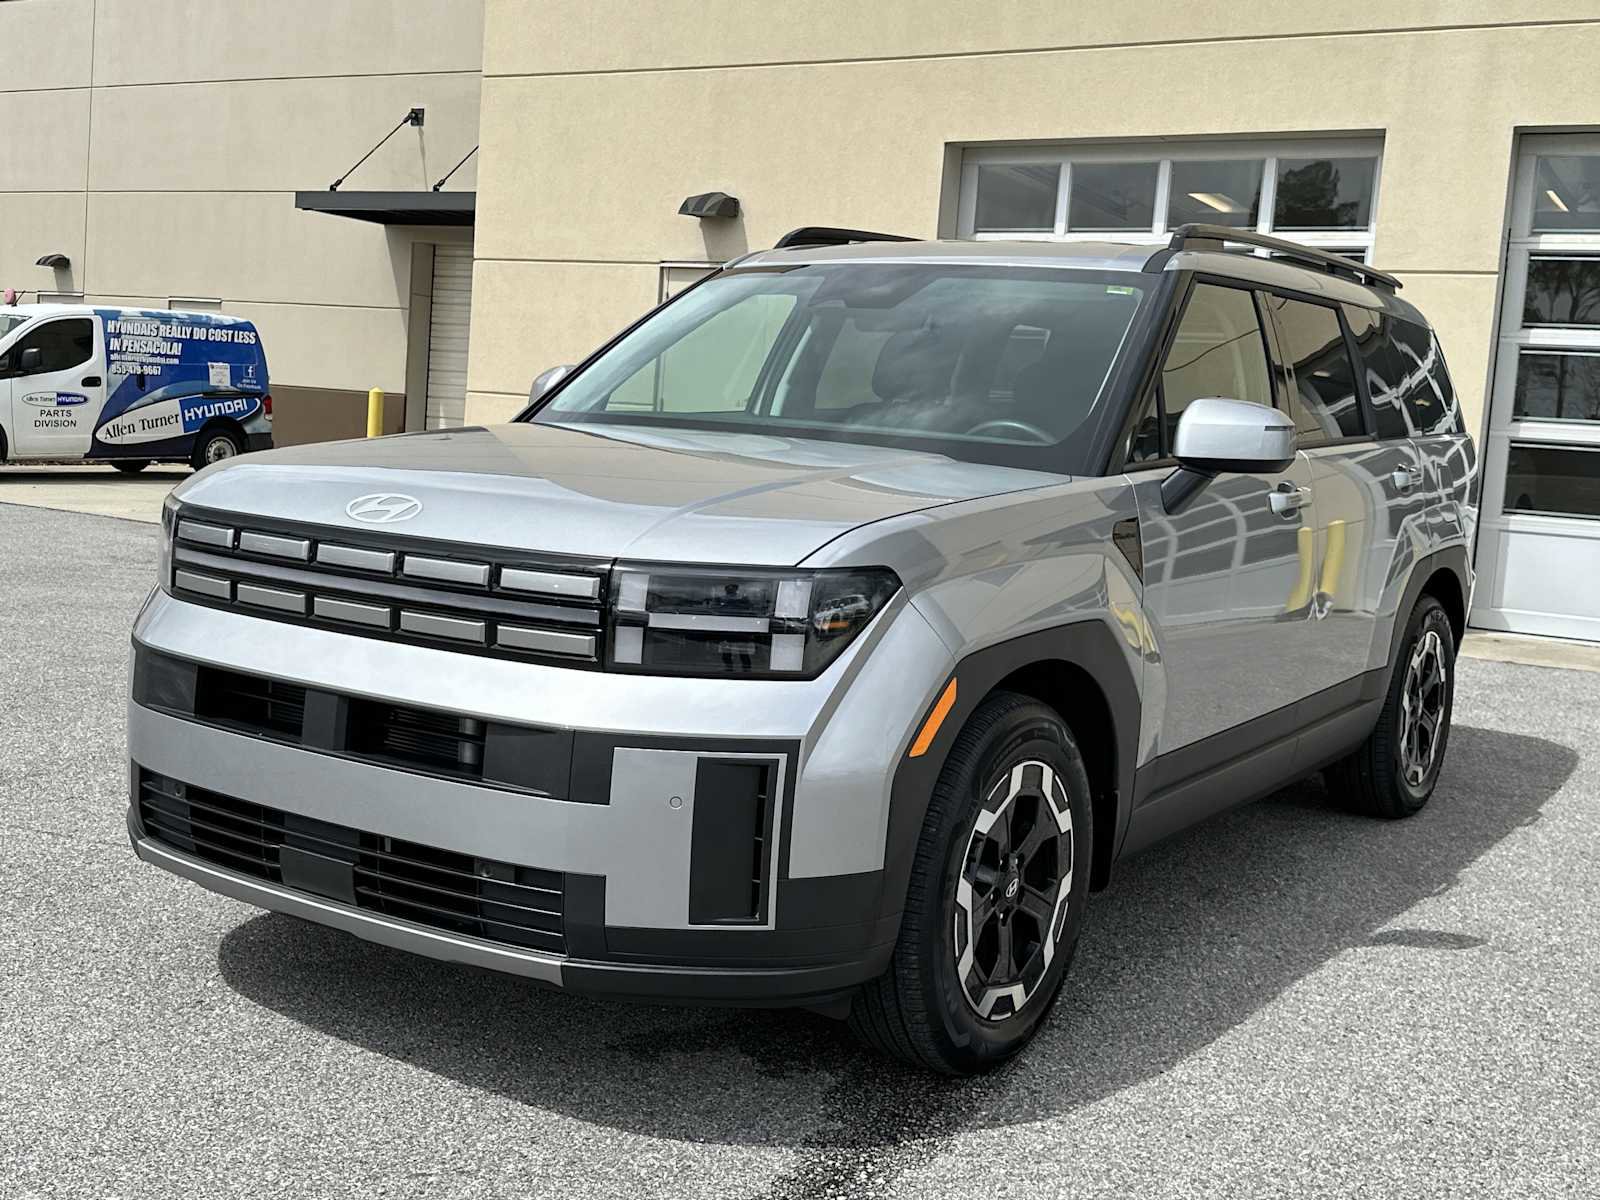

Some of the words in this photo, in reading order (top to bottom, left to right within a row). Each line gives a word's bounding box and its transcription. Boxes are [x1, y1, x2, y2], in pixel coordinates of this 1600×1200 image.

[107, 320, 158, 337] HYUNDAIS
[158, 324, 191, 339] REALLY
[192, 327, 206, 341] DO
[207, 328, 235, 343] COST
[234, 330, 256, 345] LESS
[109, 337, 121, 351] IN
[122, 339, 183, 355] PENSACOLA!
[40, 409, 72, 417] PARTS
[104, 423, 136, 440] Allen
[139, 413, 180, 431] Turner
[183, 397, 248, 422] HYUNDAI
[34, 419, 77, 428] DIVISION
